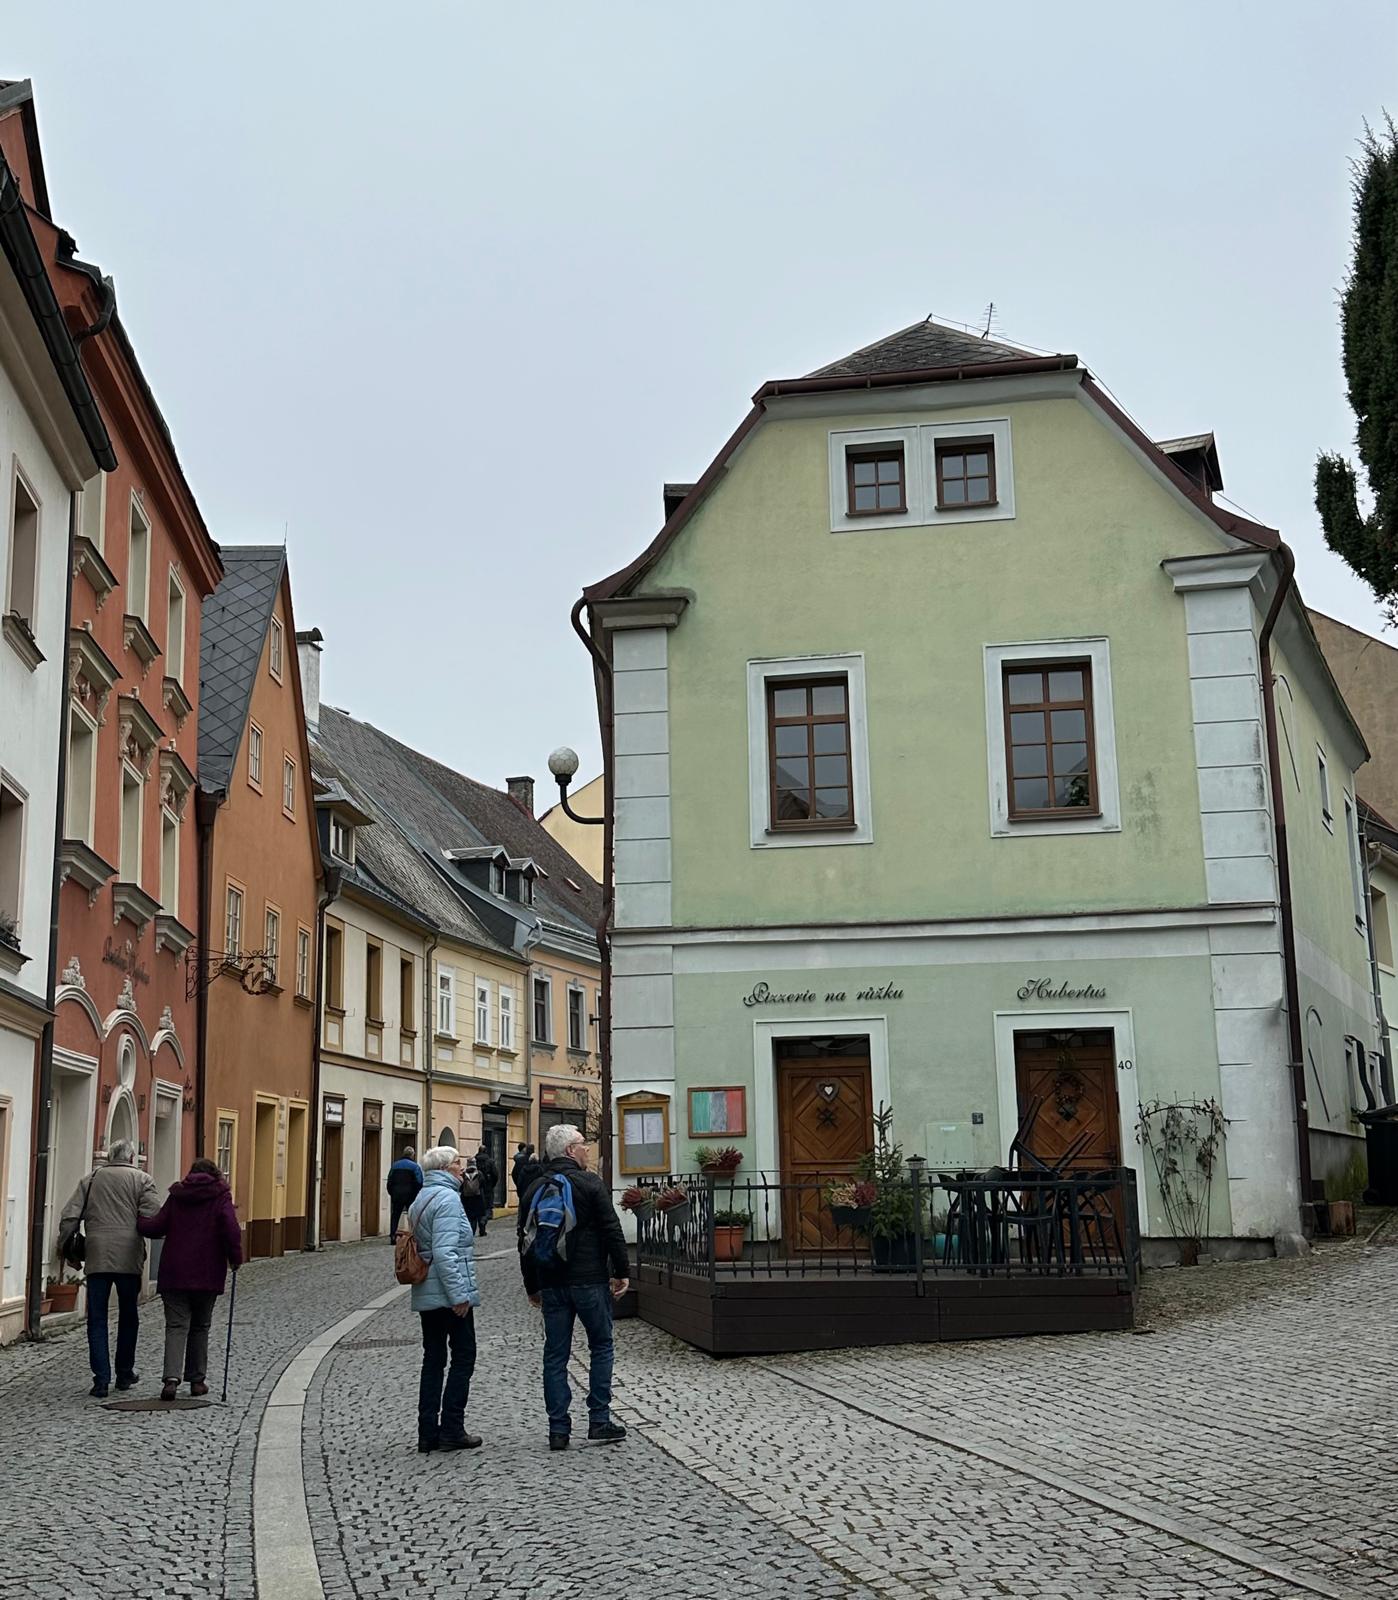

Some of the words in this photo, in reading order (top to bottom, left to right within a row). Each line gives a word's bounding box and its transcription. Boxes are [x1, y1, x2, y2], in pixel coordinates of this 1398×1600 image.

[743, 981, 817, 1007] Pizzerie
[824, 990, 847, 1003] na
[856, 980, 905, 1001] růžku
[1017, 977, 1106, 1000] Hubertus
[1117, 1059, 1133, 1071] 40
